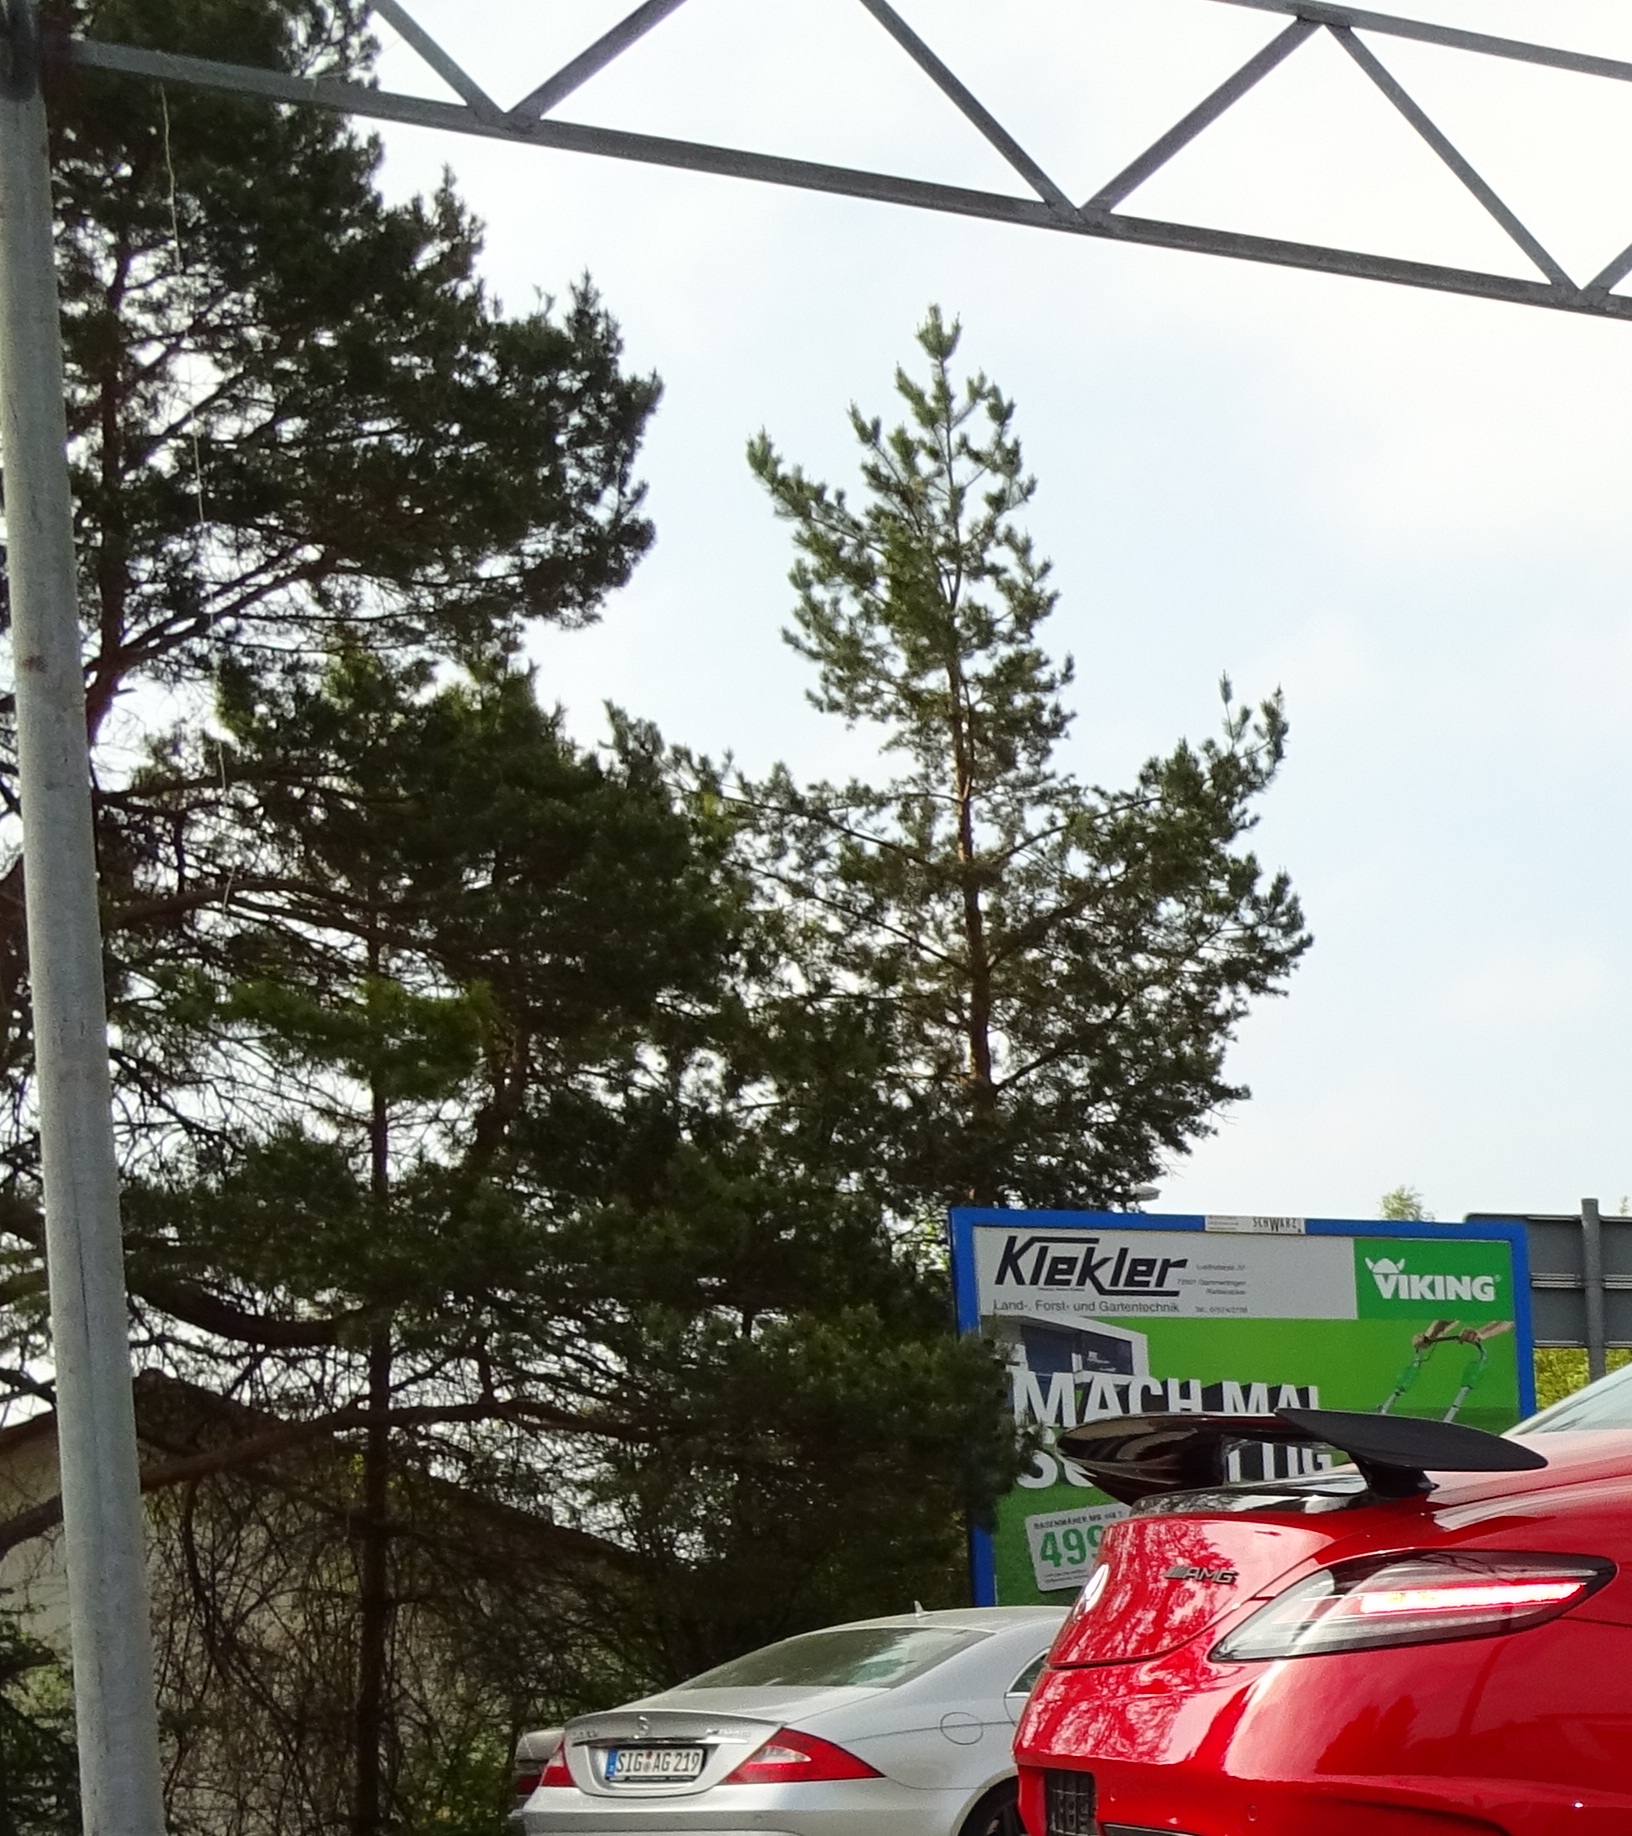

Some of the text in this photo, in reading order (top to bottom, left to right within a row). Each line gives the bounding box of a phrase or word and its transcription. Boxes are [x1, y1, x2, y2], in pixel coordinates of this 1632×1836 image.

[1035, 1299, 1071, 1312] Forst-
[1074, 1300, 1096, 1312] und
[1099, 1300, 1180, 1313] Gartentechnik
[1180, 1566, 1239, 1584] AMG
[616, 1752, 644, 1773] SIG
[652, 1752, 671, 1772] AG
[672, 1752, 700, 1772] 219
